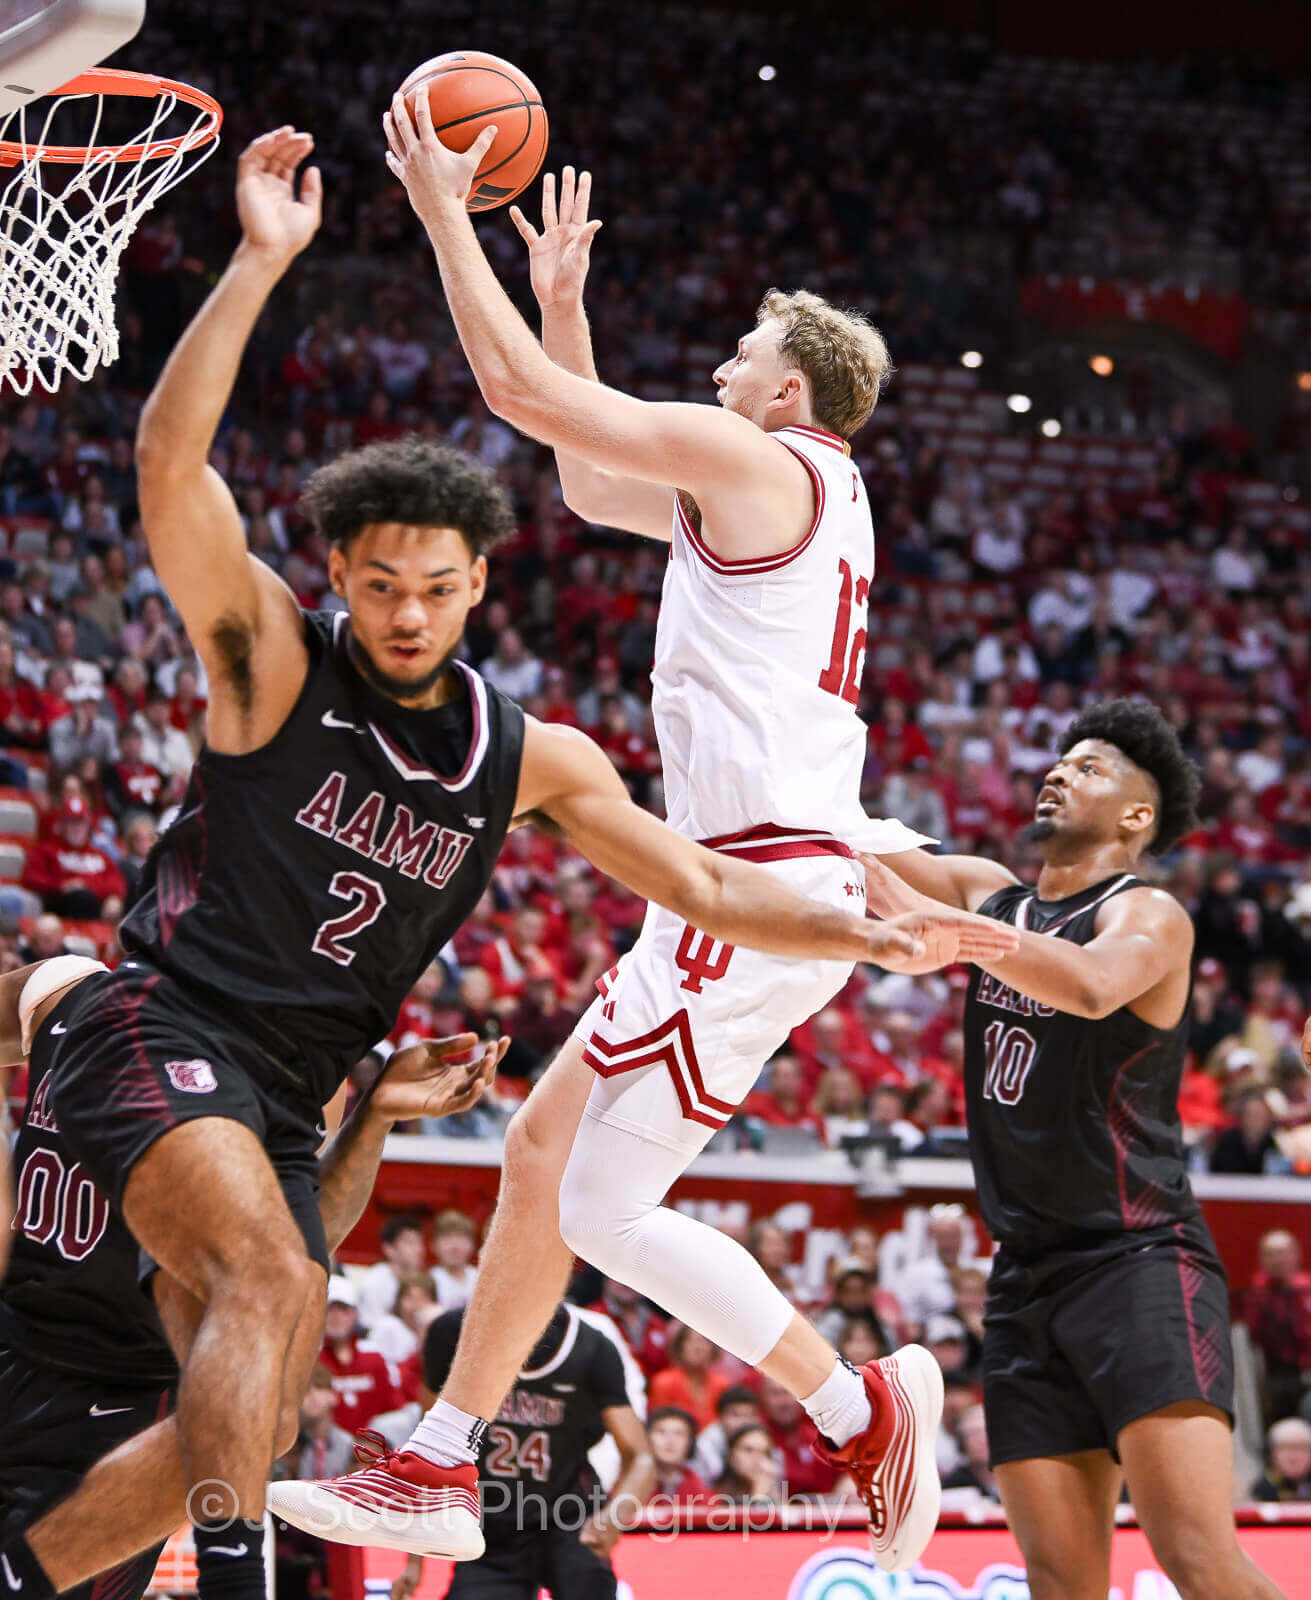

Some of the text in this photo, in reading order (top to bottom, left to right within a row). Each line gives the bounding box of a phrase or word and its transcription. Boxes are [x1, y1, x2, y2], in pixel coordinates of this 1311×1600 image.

[295, 771, 474, 890] AAMU
[311, 871, 387, 967] 2
[983, 1021, 1036, 1106] 10
[11, 1147, 109, 1261] 00
[496, 1388, 566, 1427] AMU
[486, 1426, 552, 1481] 24
